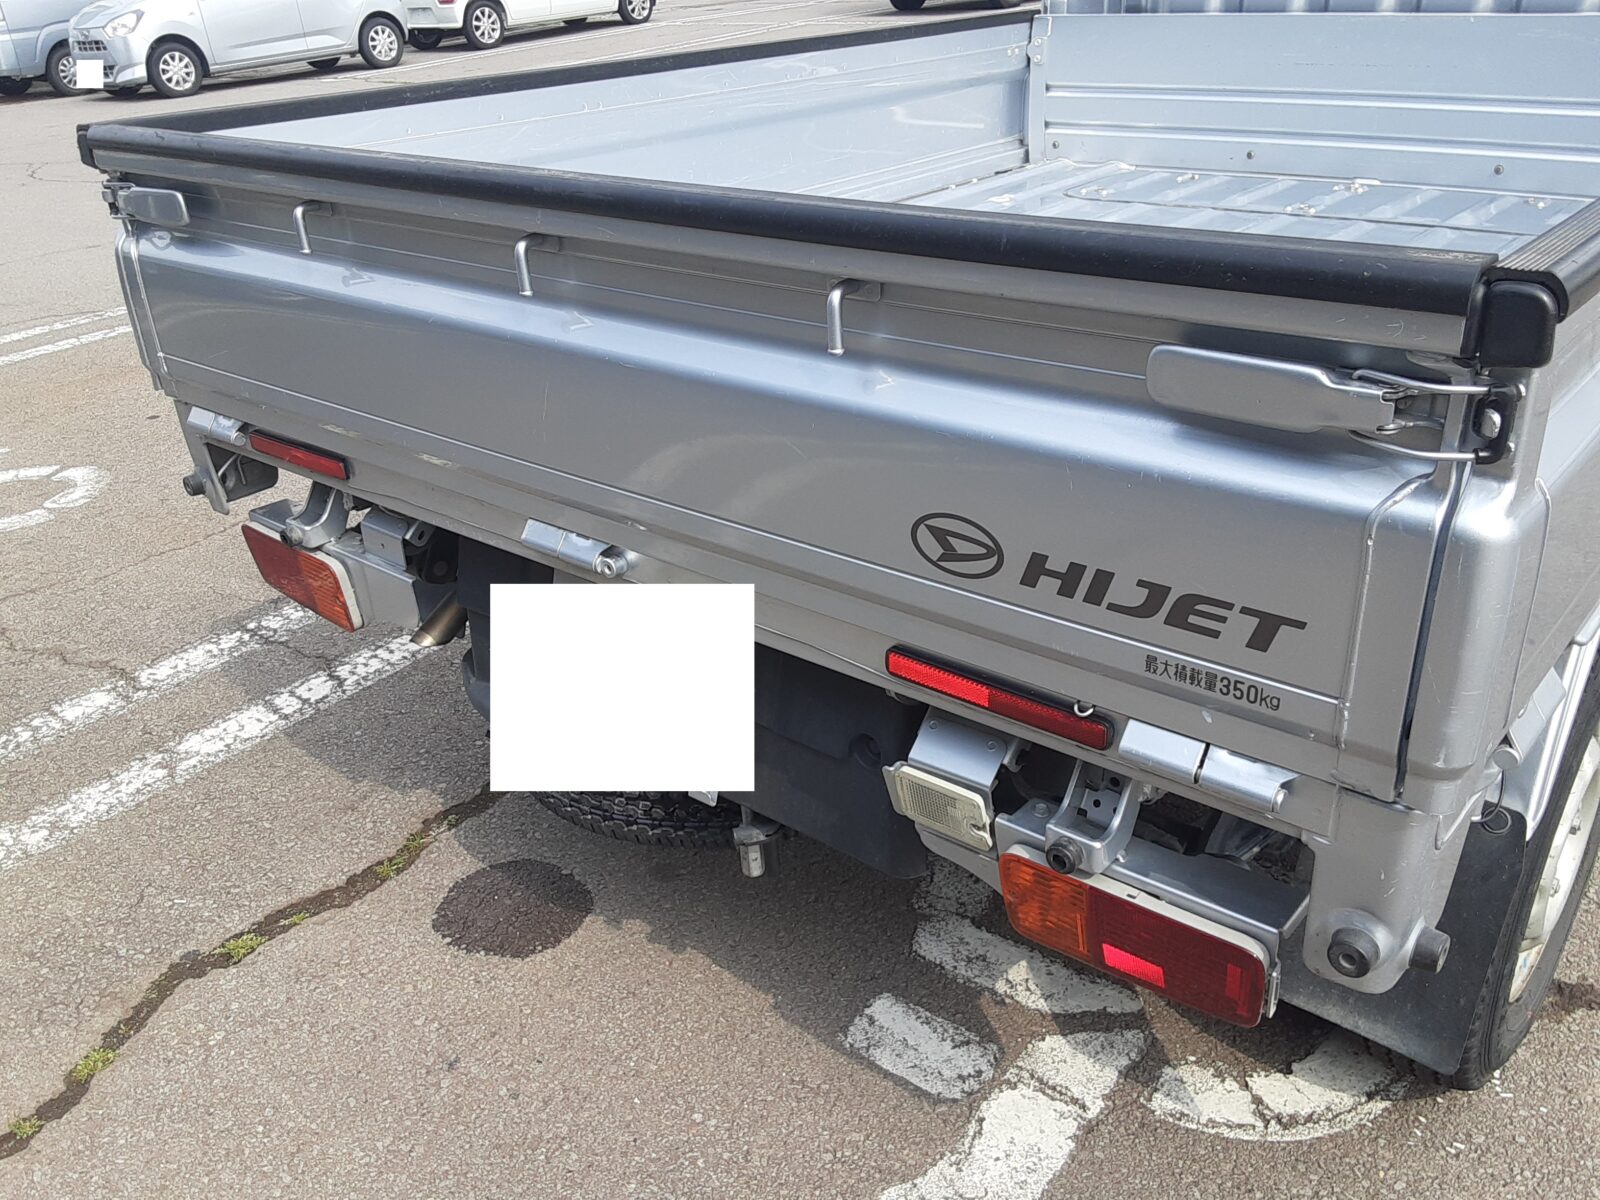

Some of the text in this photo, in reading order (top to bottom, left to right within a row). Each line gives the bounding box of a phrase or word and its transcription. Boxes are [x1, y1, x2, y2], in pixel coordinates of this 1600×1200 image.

[1019, 551, 1308, 653] HIJET
[1143, 654, 1281, 712] 最大積載量350kg
